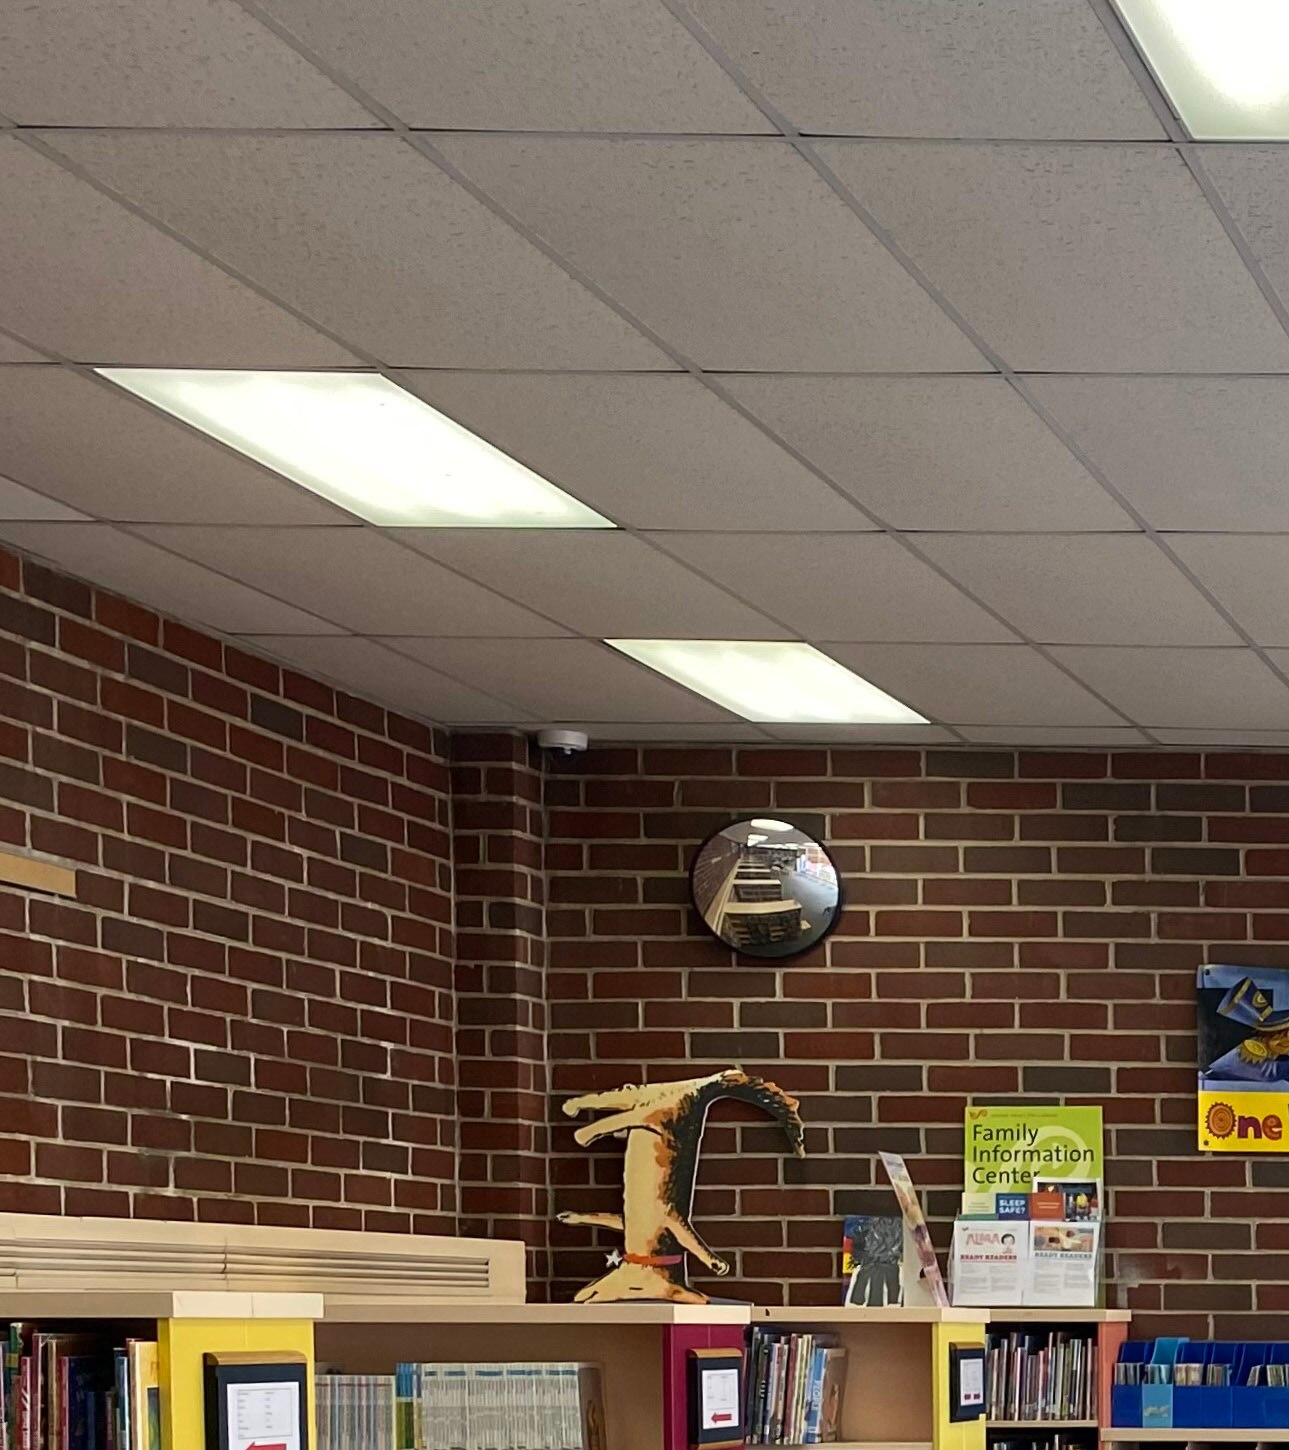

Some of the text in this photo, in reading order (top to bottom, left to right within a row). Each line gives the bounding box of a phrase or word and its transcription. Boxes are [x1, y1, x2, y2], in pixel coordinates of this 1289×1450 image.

[1205, 1101, 1284, 1140] One
[973, 1123, 1039, 1147] Family
[973, 1145, 1095, 1163] Information
[998, 1199, 1026, 1207] SLEEP
